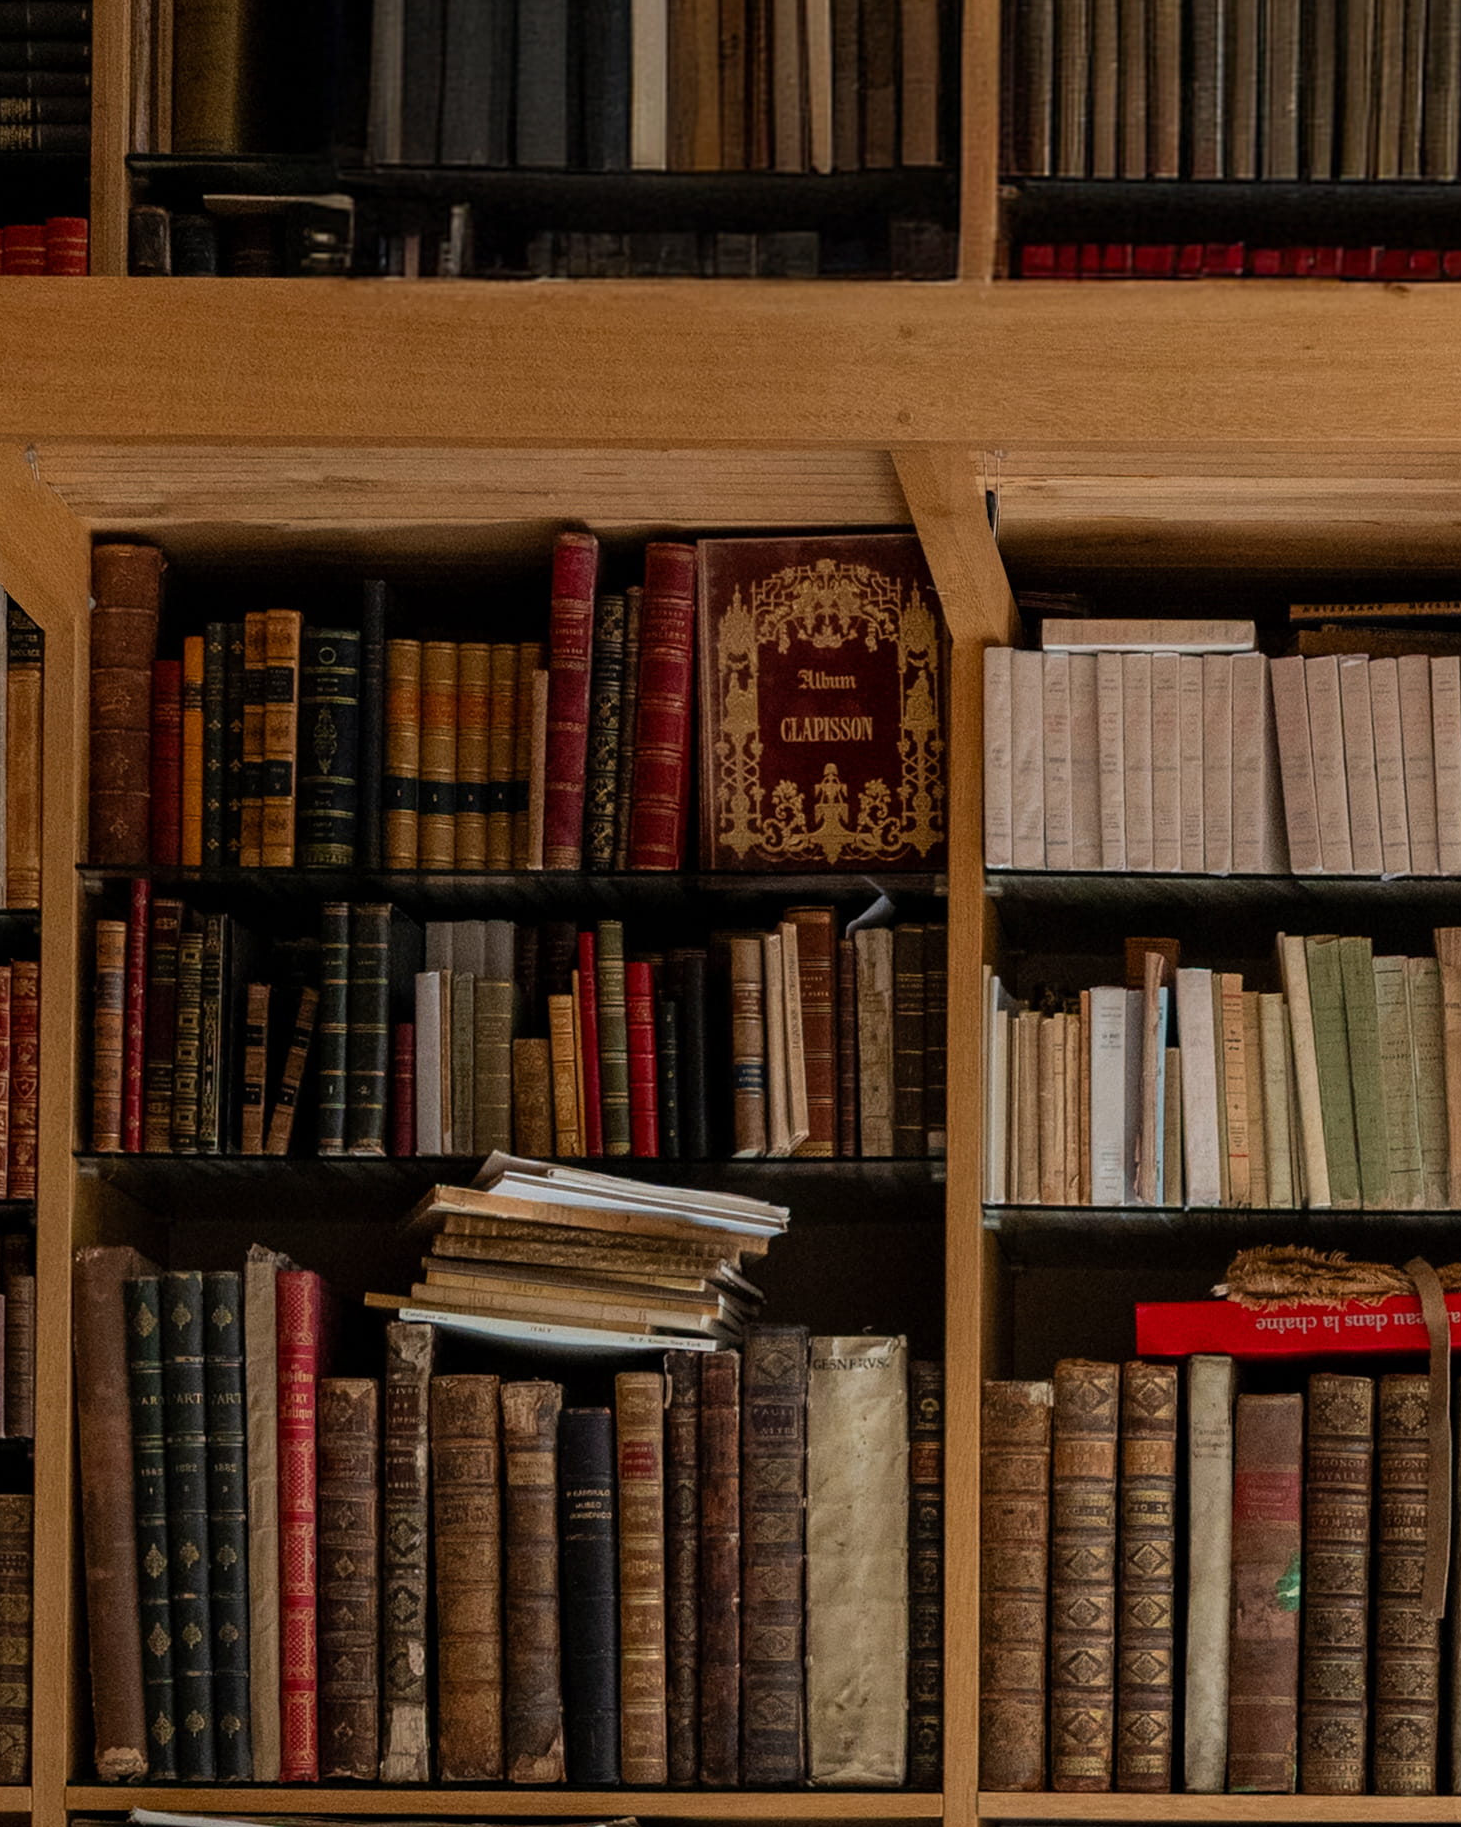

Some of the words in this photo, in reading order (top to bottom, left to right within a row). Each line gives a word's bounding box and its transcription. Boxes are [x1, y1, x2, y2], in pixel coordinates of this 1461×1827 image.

[797, 669, 857, 690] Album
[780, 716, 874, 743] CLAPISSON
[1255, 1316, 1318, 1336] chaîne
[1322, 1316, 1340, 1334] la
[1345, 1313, 1388, 1333] dans
[1392, 1311, 1461, 1328] aeau
